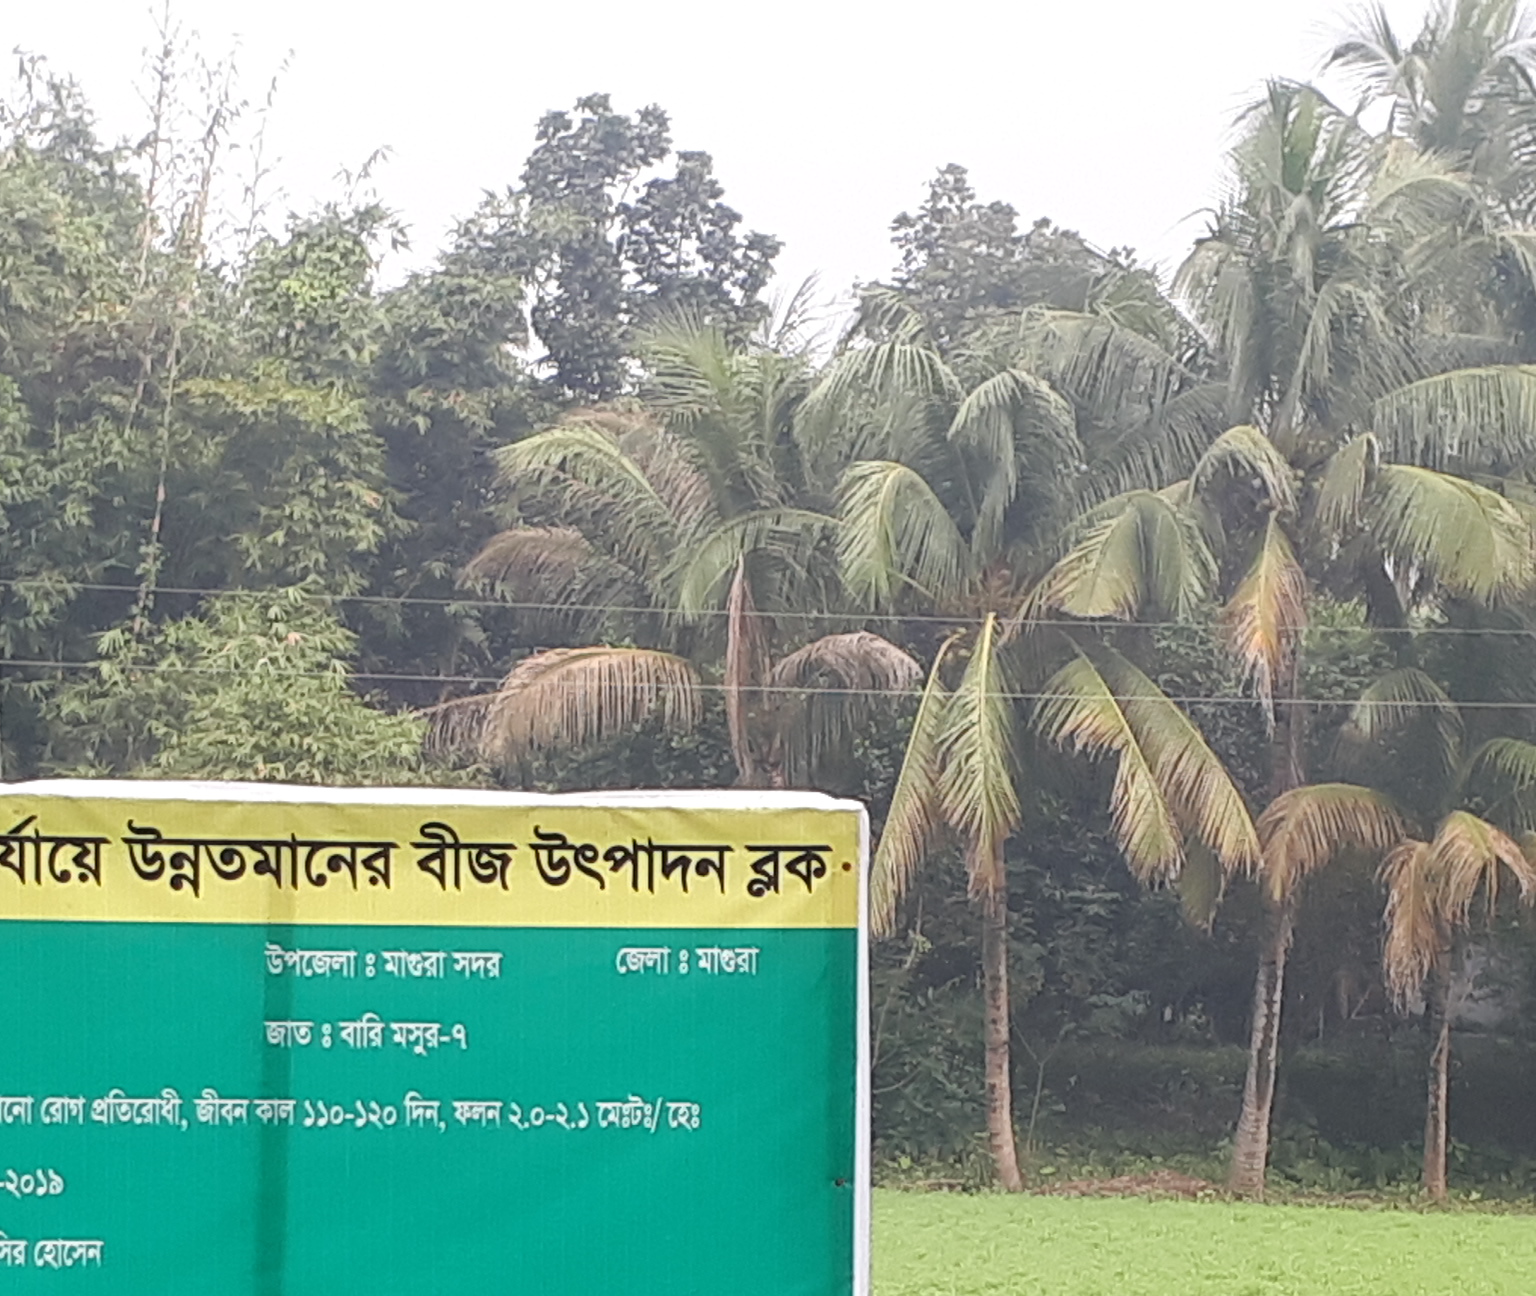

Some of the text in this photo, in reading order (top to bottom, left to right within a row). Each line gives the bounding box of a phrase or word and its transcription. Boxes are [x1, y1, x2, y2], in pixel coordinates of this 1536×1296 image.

[120, 819, 400, 897] উন্নতমানের
[409, 821, 518, 891] বীজ
[528, 825, 734, 894] উৎপাদন
[744, 844, 833, 898] ব্লক
[264, 942, 359, 978] উপজেলা
[380, 950, 448, 978] মাগুরা
[450, 951, 504, 978] সদর
[615, 946, 672, 974] জেলা
[694, 946, 761, 974] মাগুরা
[264, 1020, 315, 1047] জাত
[337, 1012, 386, 1049] বারি
[389, 1022, 467, 1056] মসুর-৭
[40, 1095, 87, 1124] রোগ
[90, 1087, 188, 1129] প্রতিরোধী,
[193, 1088, 251, 1125] জীবন
[252, 1098, 297, 1125] কাল
[302, 1099, 397, 1128] ১১০-১২০
[403, 1090, 446, 1131] দিন,
[452, 1100, 504, 1125] ফলন
[508, 1102, 590, 1130] ২.০-২.১
[33, 1238, 105, 1269] হোসেন
